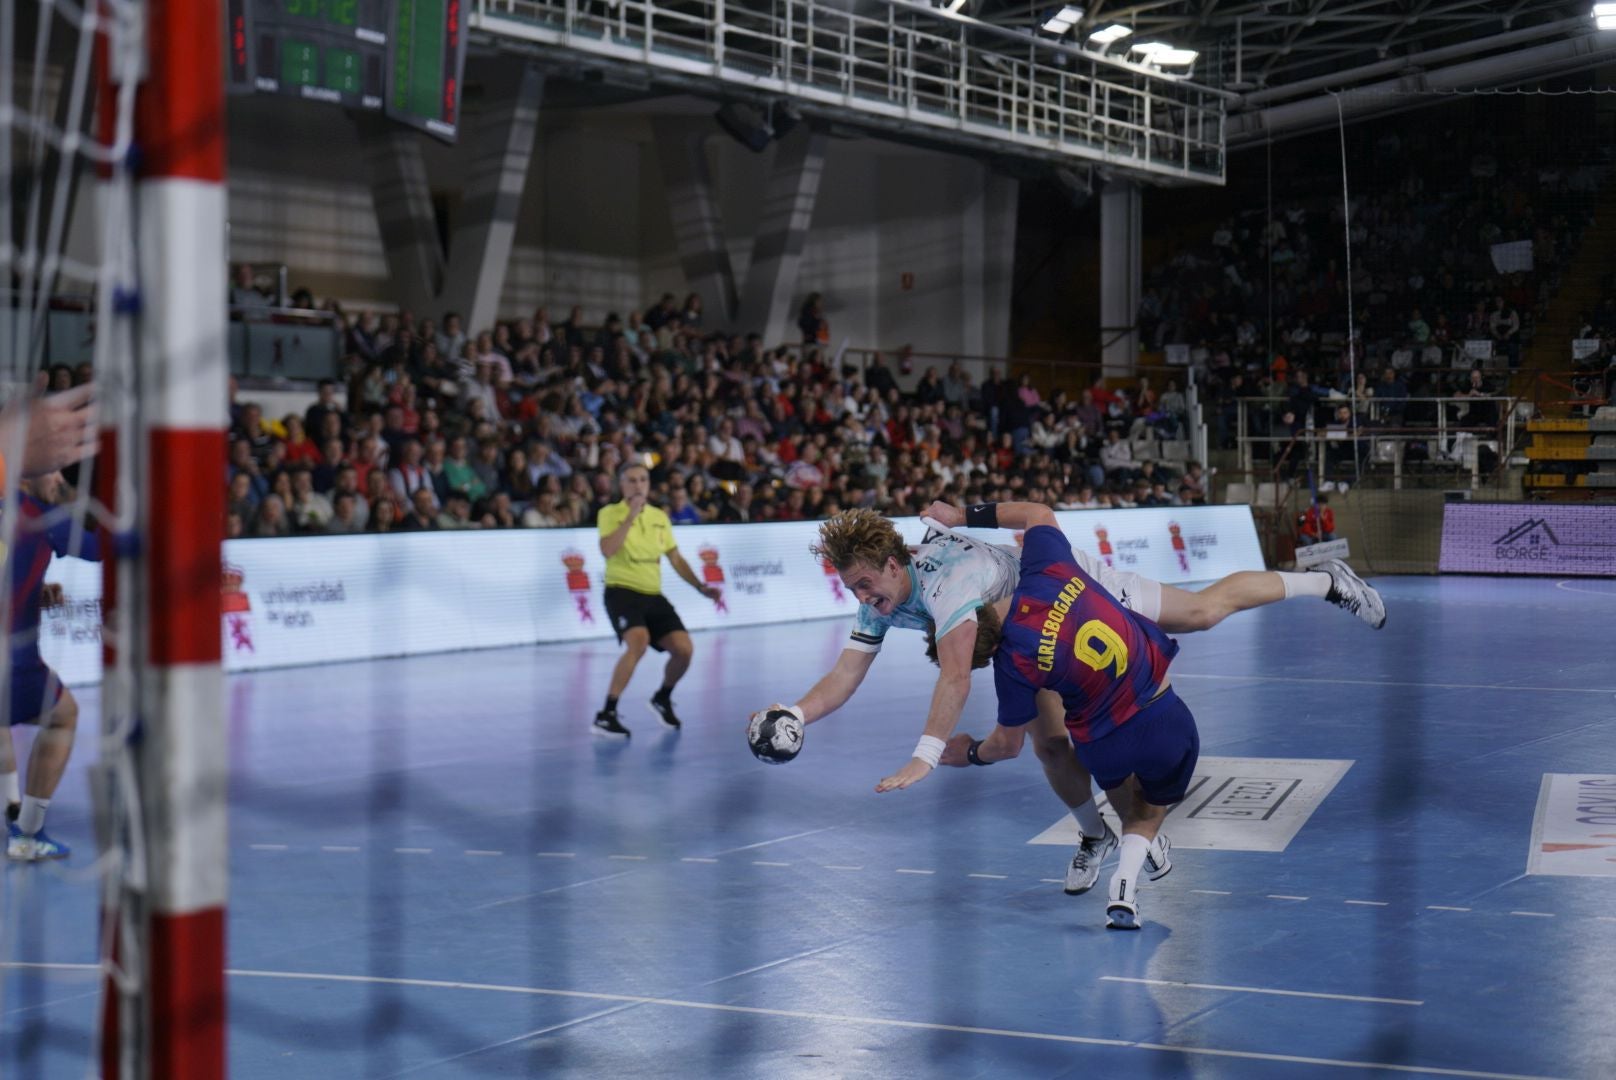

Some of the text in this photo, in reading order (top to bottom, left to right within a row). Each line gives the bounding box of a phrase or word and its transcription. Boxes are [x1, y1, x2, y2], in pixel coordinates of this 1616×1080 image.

[260, 578, 346, 604] universidad
[1037, 576, 1086, 672] CARLSBOGARD
[1073, 618, 1129, 678] 9
[1221, 781, 1281, 804] TEZZA
